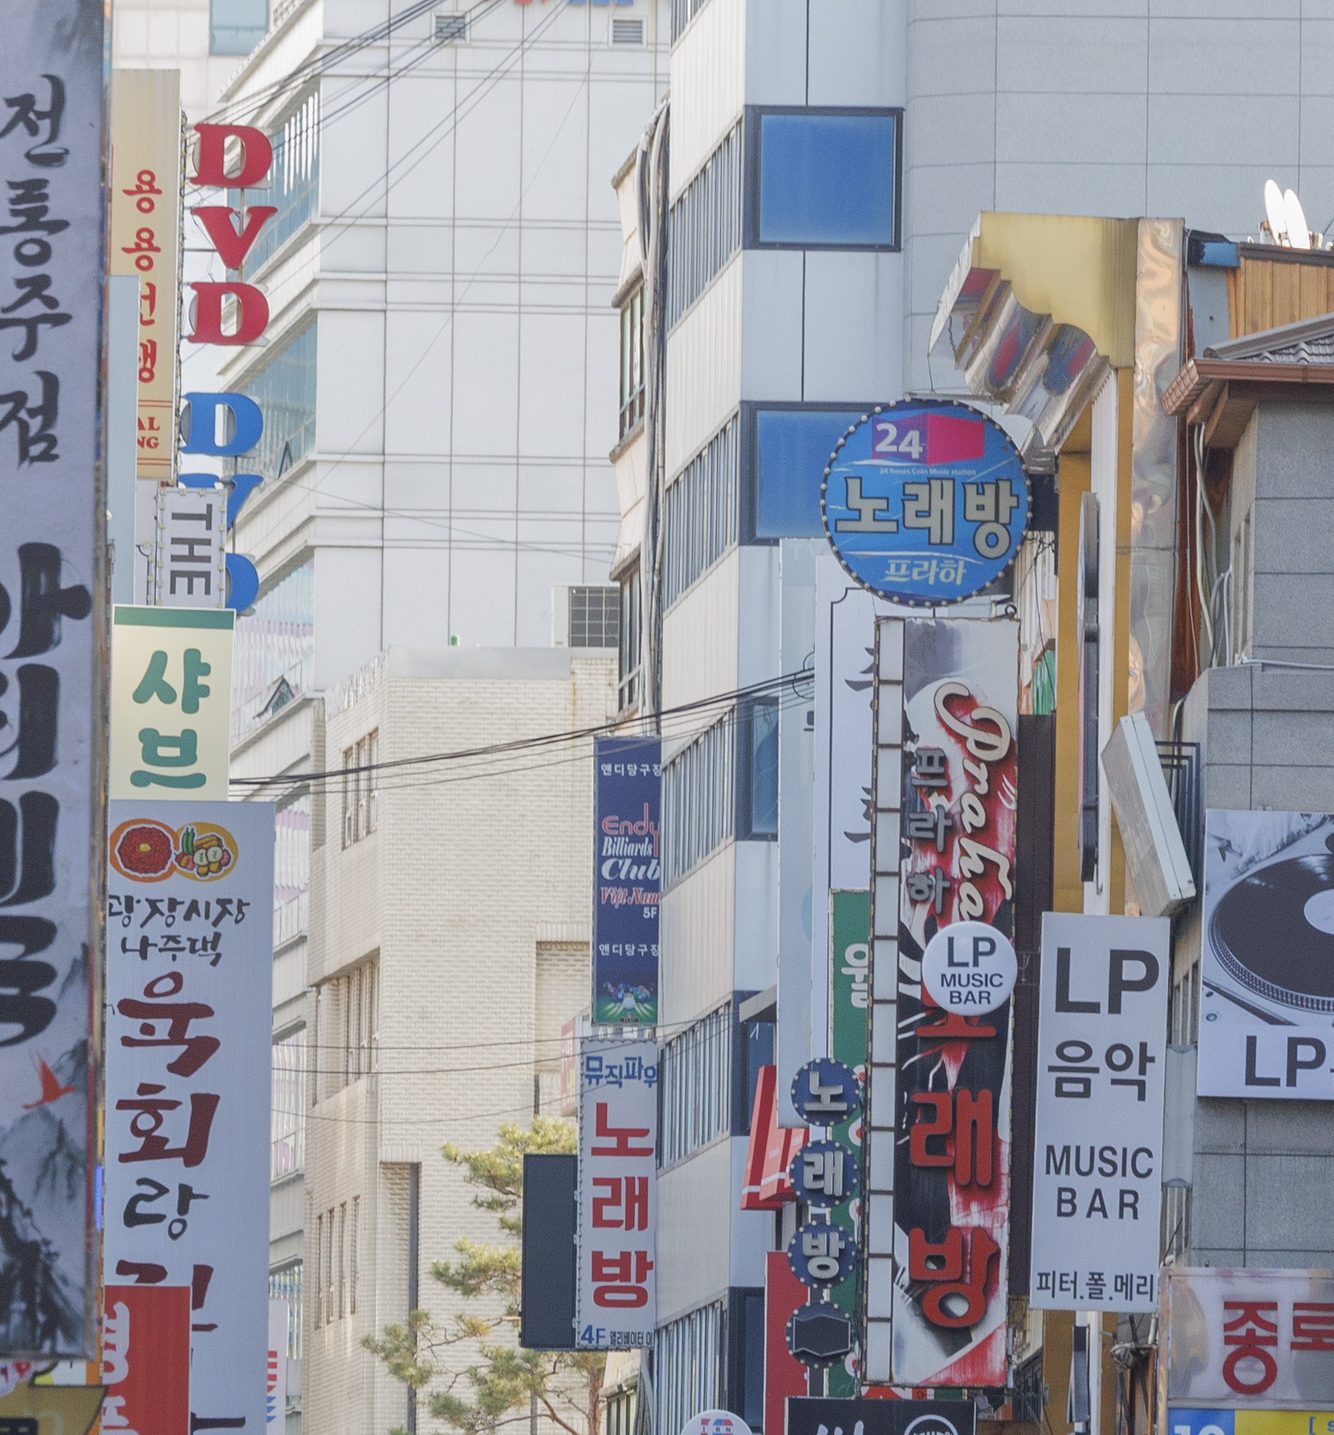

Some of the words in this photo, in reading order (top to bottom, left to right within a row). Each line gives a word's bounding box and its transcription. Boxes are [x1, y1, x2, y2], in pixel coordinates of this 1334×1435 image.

[187, 123, 277, 345] DVD
[875, 423, 924, 459] 24
[890, 467, 910, 475] hours
[912, 467, 928, 475] Coin
[929, 467, 950, 475] Music
[951, 468, 977, 476] station
[834, 475, 1020, 560] 노래방
[169, 503, 213, 596] THE
[882, 558, 967, 586] 프라하
[601, 803, 661, 857] Endy
[601, 836, 653, 858] Billiards
[907, 747, 954, 916] 프라하
[601, 857, 661, 881] Club
[108, 894, 251, 929] 광장시장
[642, 907, 658, 919] 5F
[120, 931, 223, 968] 나주댁
[947, 935, 997, 968] LP
[940, 973, 1004, 988] MUSIC
[948, 990, 992, 1006] BAR
[1054, 947, 1160, 1016] LP
[1047, 1039, 1156, 1102] 음악
[114, 970, 222, 1241] 육회랑
[801, 1070, 849, 1280] 노래방
[1044, 1144, 1155, 1179] MUSIC
[590, 1102, 655, 1309] 노래방
[1056, 1187, 1140, 1220] BAR
[581, 1324, 607, 1346] 4F
